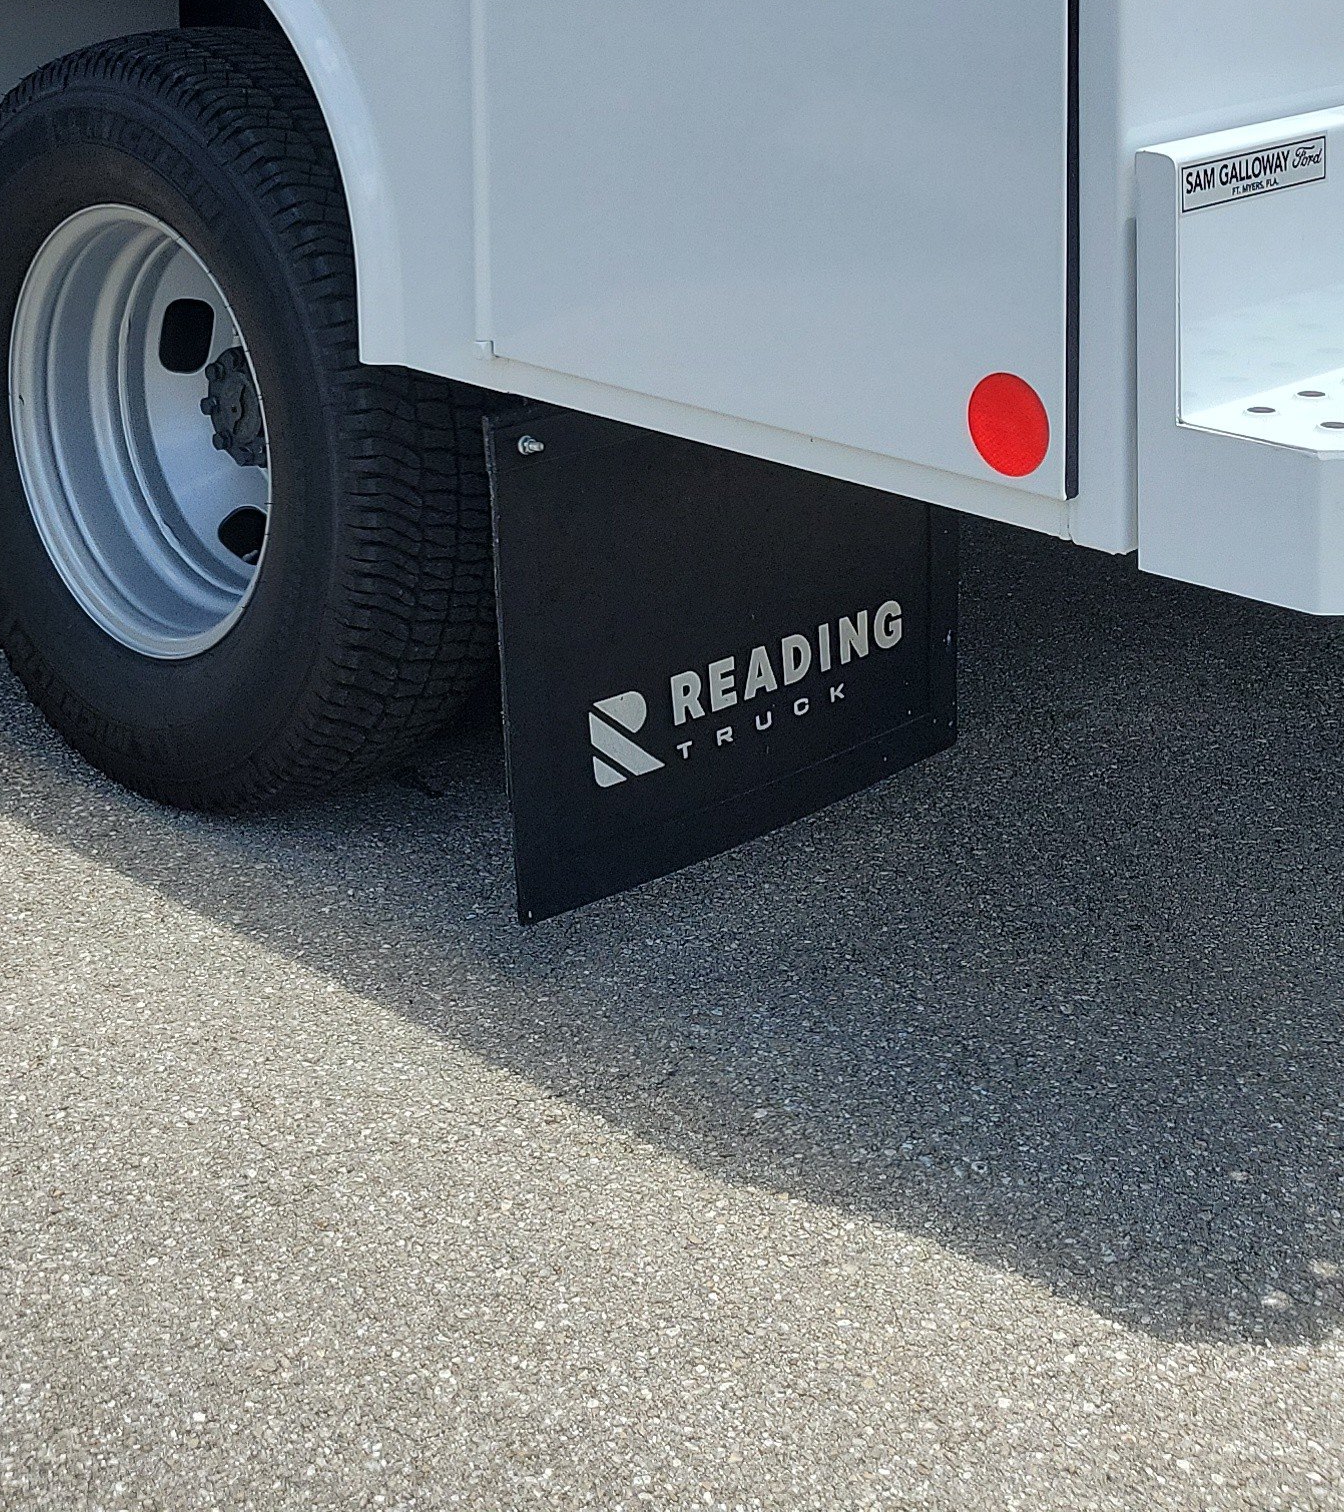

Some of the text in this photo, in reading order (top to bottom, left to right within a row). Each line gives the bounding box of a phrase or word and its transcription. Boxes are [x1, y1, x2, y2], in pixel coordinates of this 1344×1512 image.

[1185, 144, 1322, 194] SAM GALLOWAY Ford
[670, 600, 905, 726] READING
[676, 682, 846, 760] TRUCK
